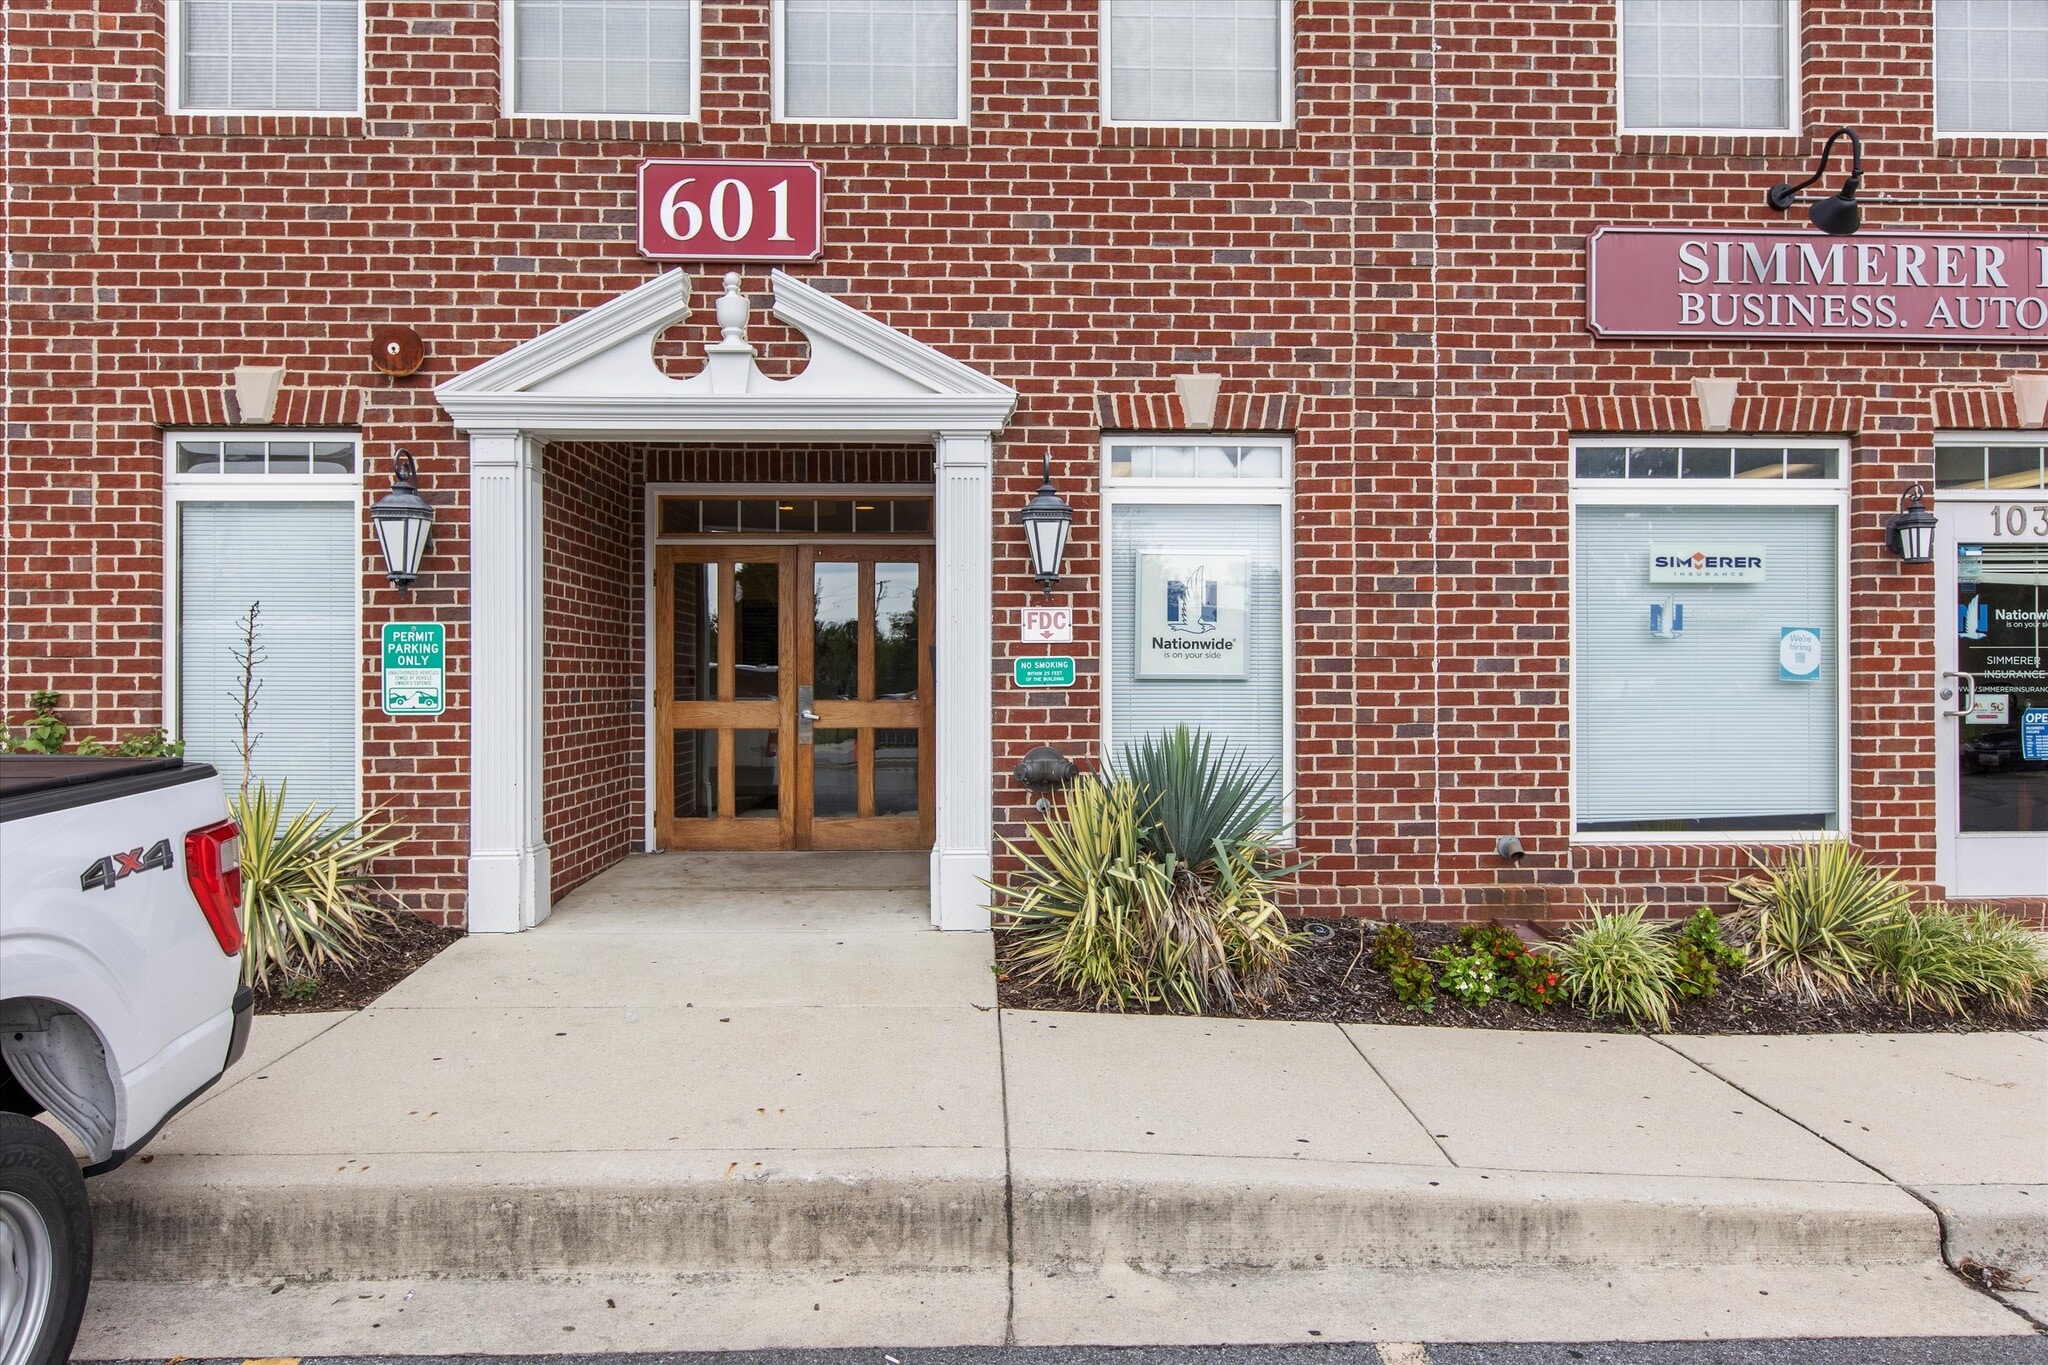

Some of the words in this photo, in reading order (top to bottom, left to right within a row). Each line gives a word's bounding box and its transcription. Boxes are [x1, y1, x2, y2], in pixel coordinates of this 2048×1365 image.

[660, 178, 796, 242] 601
[1678, 241, 2009, 288] SIMMERER
[1925, 296, 2048, 330] AUTO
[1991, 505, 2048, 536] 103
[1027, 611, 1067, 630] FDC
[393, 631, 435, 642] PERMIT
[1790, 634, 1812, 642] We're
[388, 643, 439, 654] PARKING
[1152, 637, 1234, 650] Nationwide
[1789, 642, 1812, 652] hiring
[397, 655, 430, 666] ONLY
[1185, 652, 1203, 660] your
[1205, 651, 1222, 659] side
[1986, 656, 2041, 665] SIMMERER
[1034, 661, 1069, 669] SMOKING
[1984, 670, 2046, 679] INSURANCE
